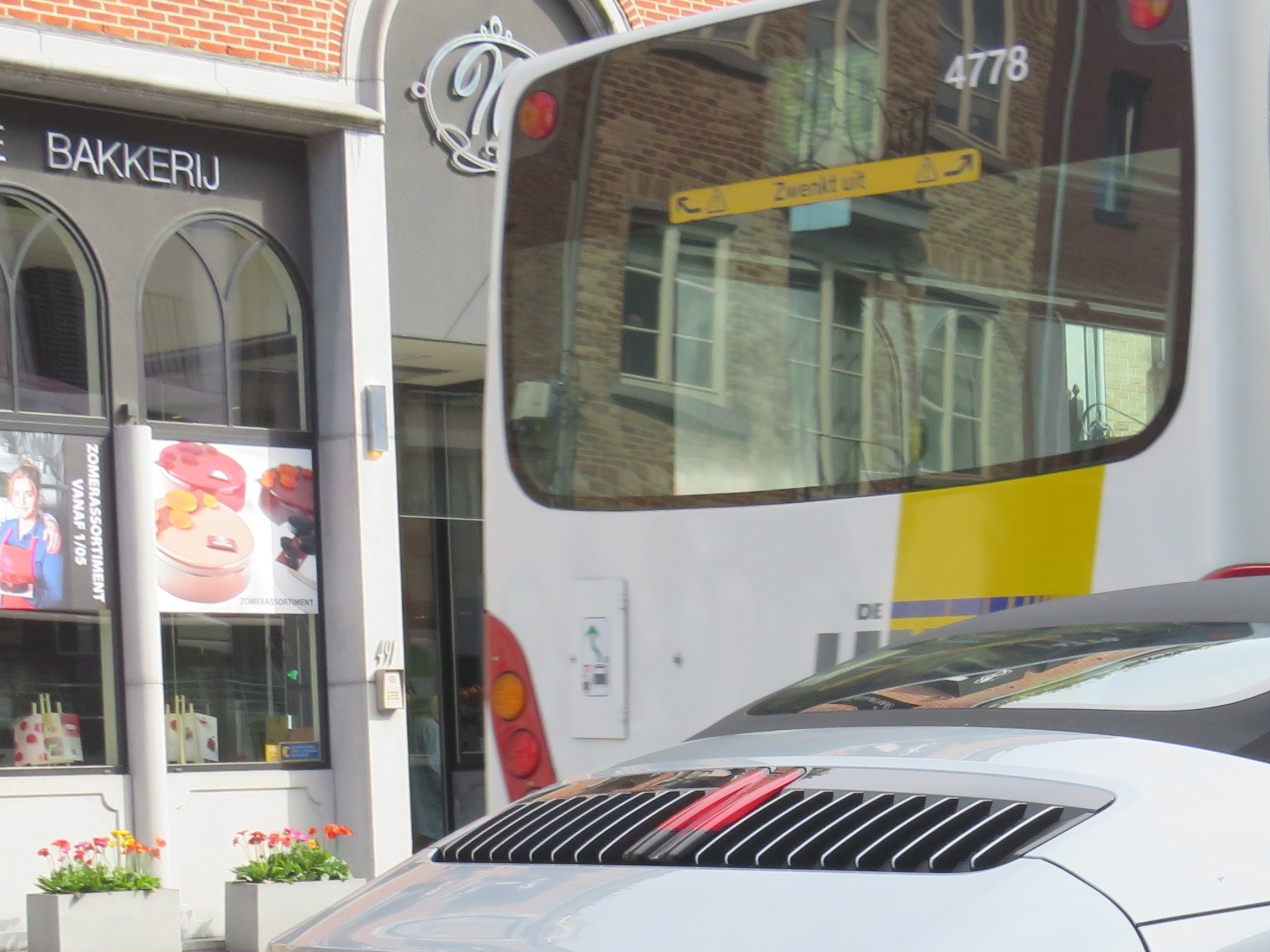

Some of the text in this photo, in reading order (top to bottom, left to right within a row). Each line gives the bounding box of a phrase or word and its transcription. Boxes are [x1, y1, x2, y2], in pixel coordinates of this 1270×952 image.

[944, 45, 1030, 90] 4778
[46, 131, 221, 191] BAKKERIJ
[773, 170, 866, 202] Zwenkt uit
[71, 478, 88, 567] VANAF 1/05
[86, 442, 106, 604] ZOMERASSORTIMENT
[240, 597, 314, 607] ZOMERASSORTIMENT
[856, 603, 884, 621] DE
